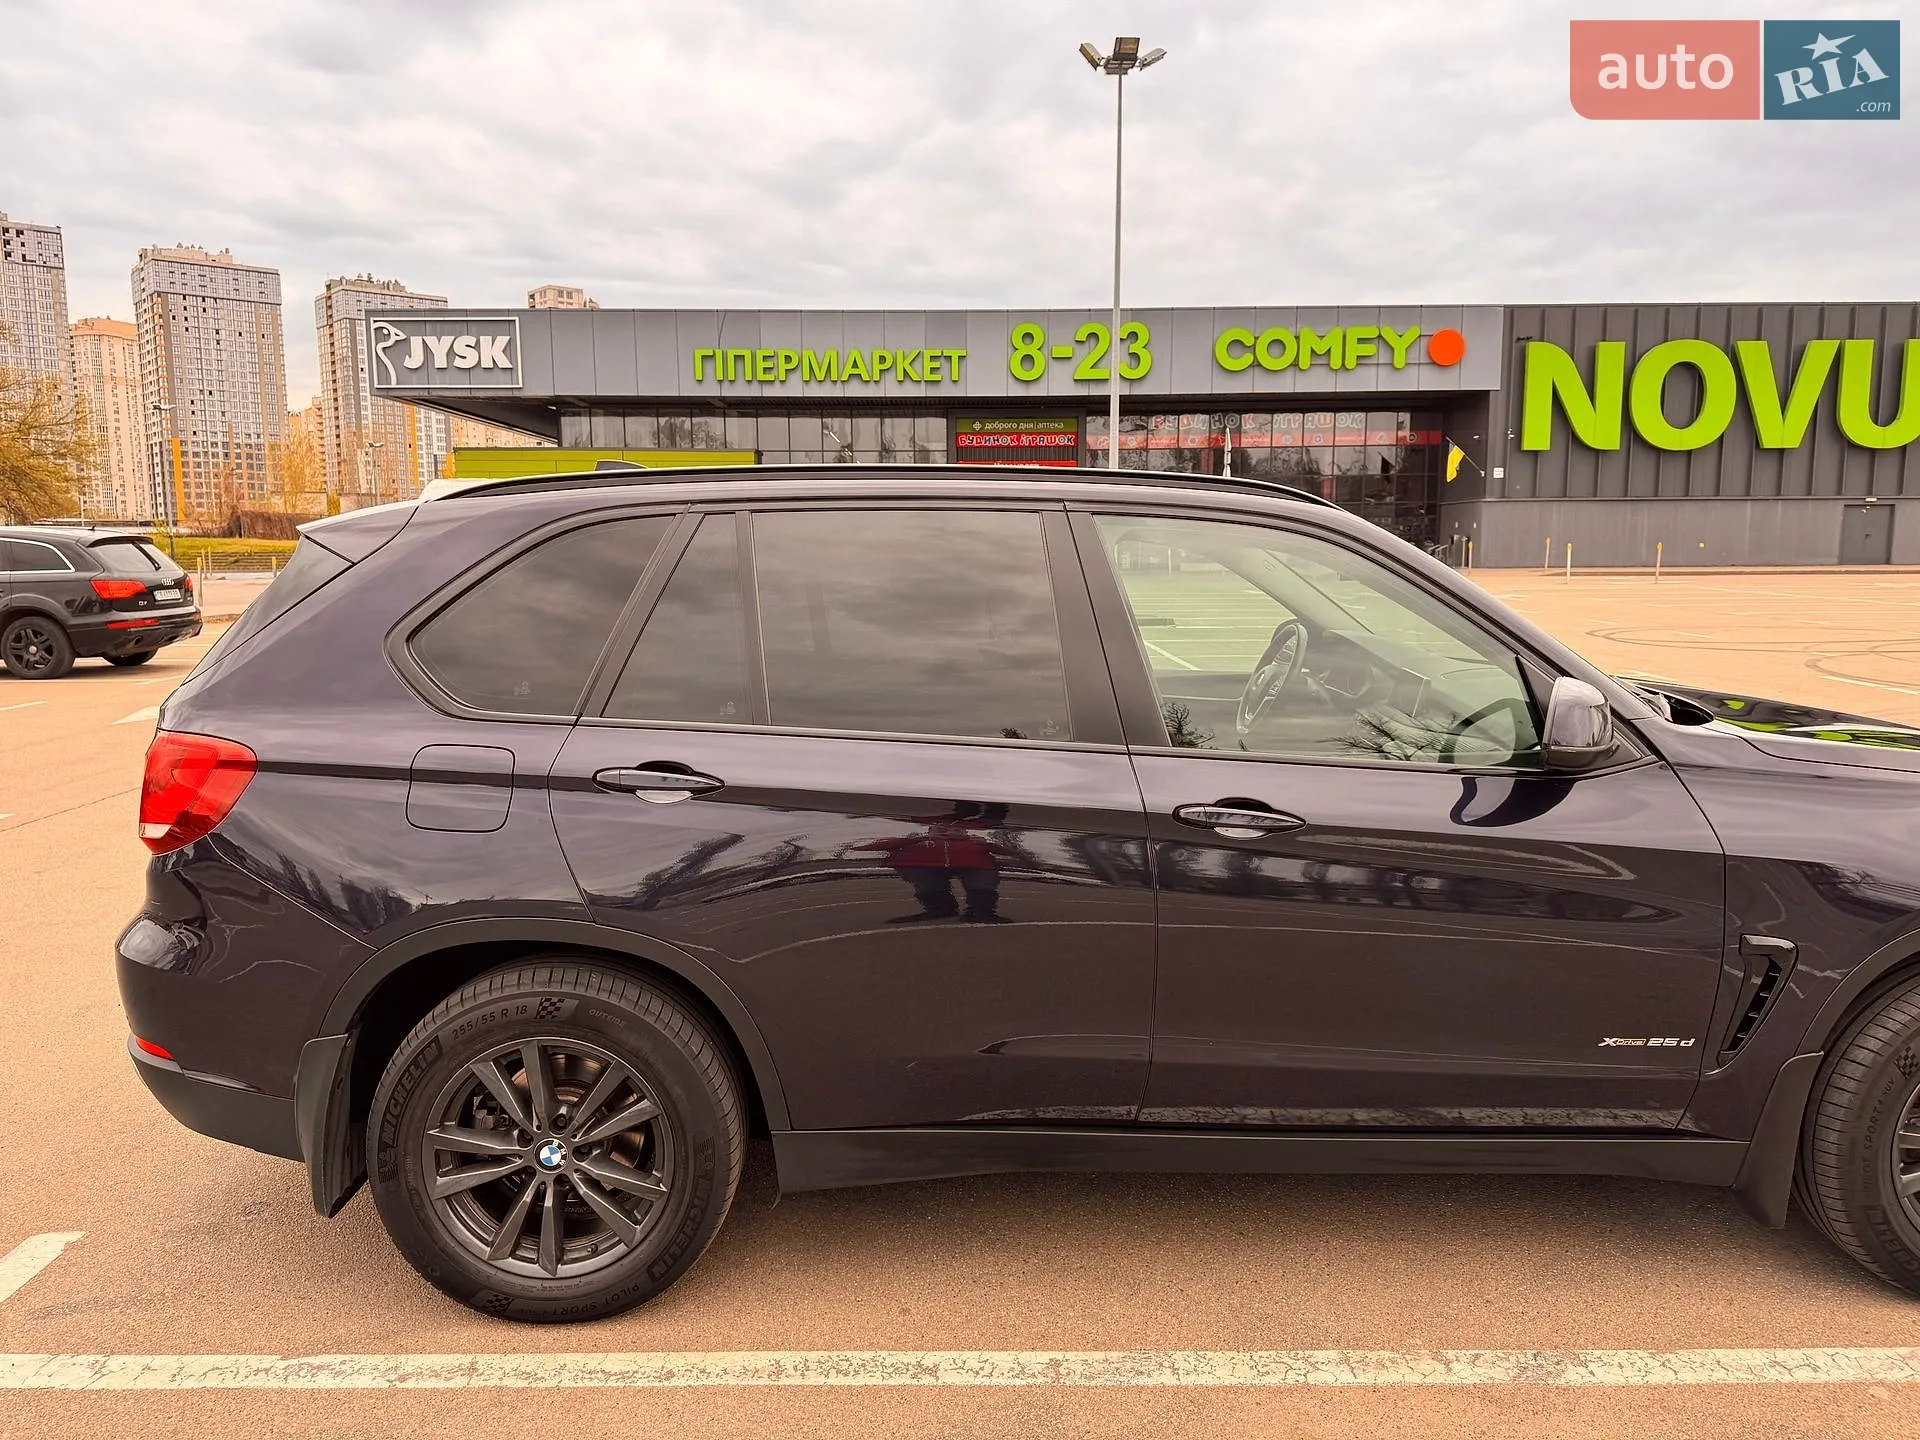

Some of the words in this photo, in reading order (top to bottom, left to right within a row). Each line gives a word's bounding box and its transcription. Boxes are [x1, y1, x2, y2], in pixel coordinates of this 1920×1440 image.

[403, 335, 513, 369] JYSK
[692, 348, 968, 383] ГІПЕРМАРКЕТ
[1009, 321, 1153, 382] 8-23
[1214, 325, 1422, 372] COMFY
[1520, 338, 1920, 452] NOVU
[959, 433, 1018, 447] БУДИНОК
[984, 421, 1018, 433] доброго
[452, 1012, 496, 1041] 255/55
[501, 1008, 509, 1019] R
[515, 1004, 528, 1016] 18
[382, 1041, 441, 1145] MICHELIN
